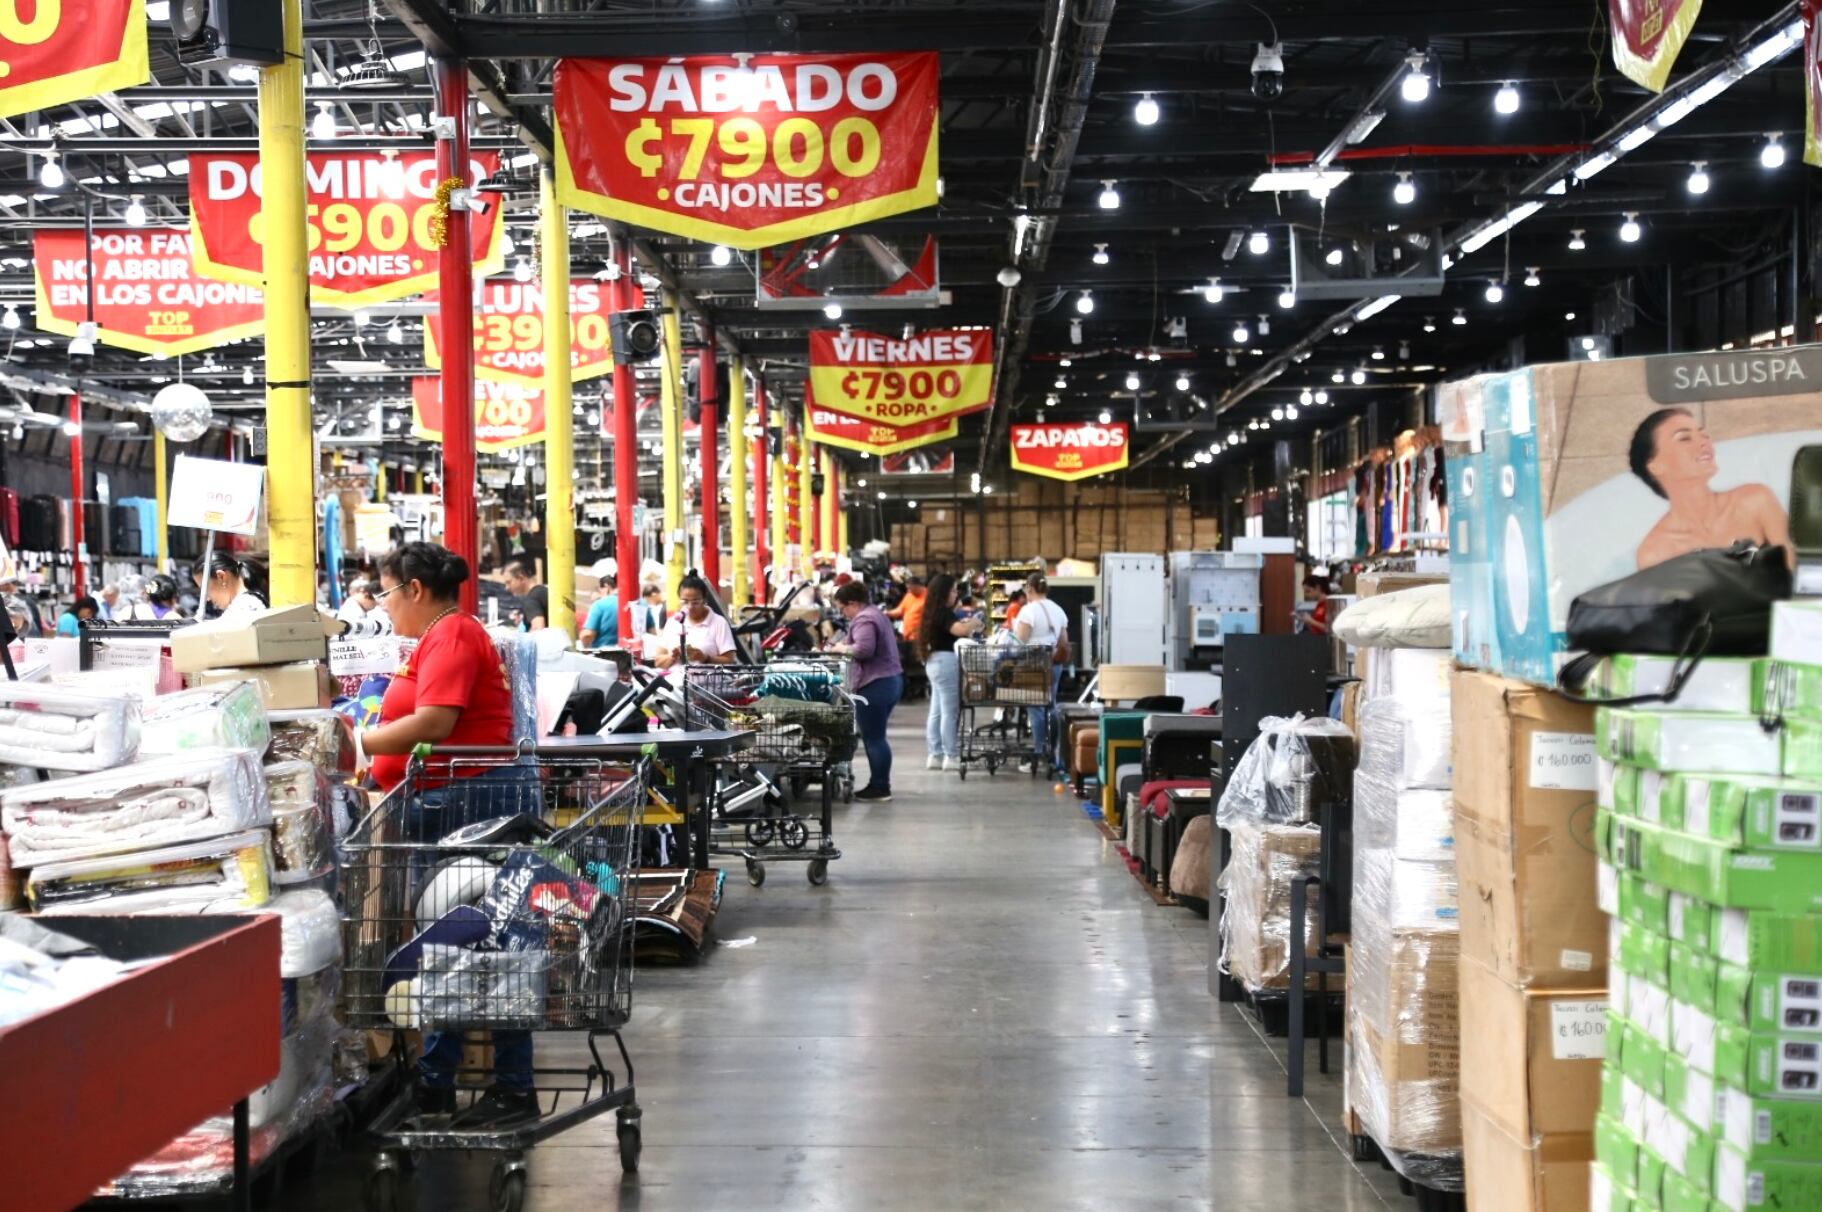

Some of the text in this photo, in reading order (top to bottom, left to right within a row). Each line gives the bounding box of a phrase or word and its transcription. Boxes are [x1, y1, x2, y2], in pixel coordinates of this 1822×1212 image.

[608, 58, 898, 113] SÁBADO
[624, 117, 882, 180] ¢7900
[674, 183, 824, 212] CAJONES
[103, 259, 189, 280] ABRIR
[51, 284, 88, 306] EN
[97, 284, 152, 305] LOS
[148, 311, 190, 325] TOP
[831, 335, 973, 363] VIERNES
[841, 369, 962, 401] ¢7900
[1674, 357, 1806, 389] SALUSPA
[813, 411, 837, 425] EN
[876, 403, 928, 417] ROPA
[1016, 428, 1124, 448] ZAPATOS
